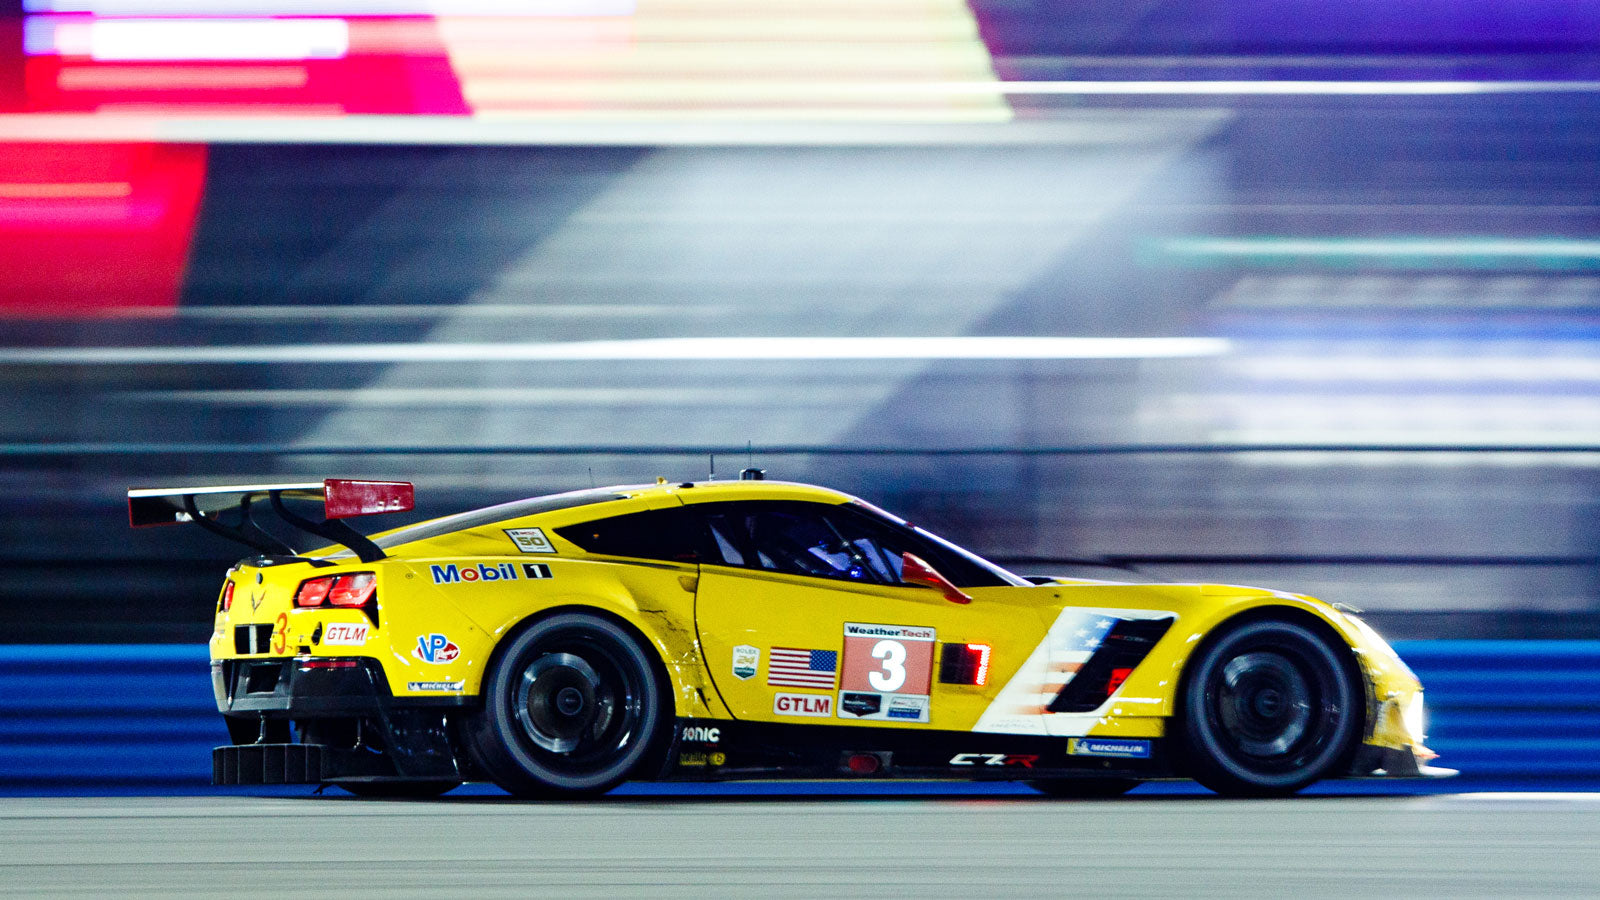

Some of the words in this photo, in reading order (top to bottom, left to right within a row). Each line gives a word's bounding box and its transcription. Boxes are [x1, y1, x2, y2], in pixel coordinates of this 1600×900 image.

[517, 537, 545, 546] 50
[430, 563, 518, 583] Mobil
[274, 612, 288, 655] 3
[327, 627, 366, 641] GTLM
[847, 626, 932, 638] WeatherTech
[418, 634, 447, 662] VP
[868, 639, 907, 692] 3
[967, 643, 991, 686] 7
[776, 696, 830, 713] GTLM
[1090, 744, 1144, 753] MICHELIN
